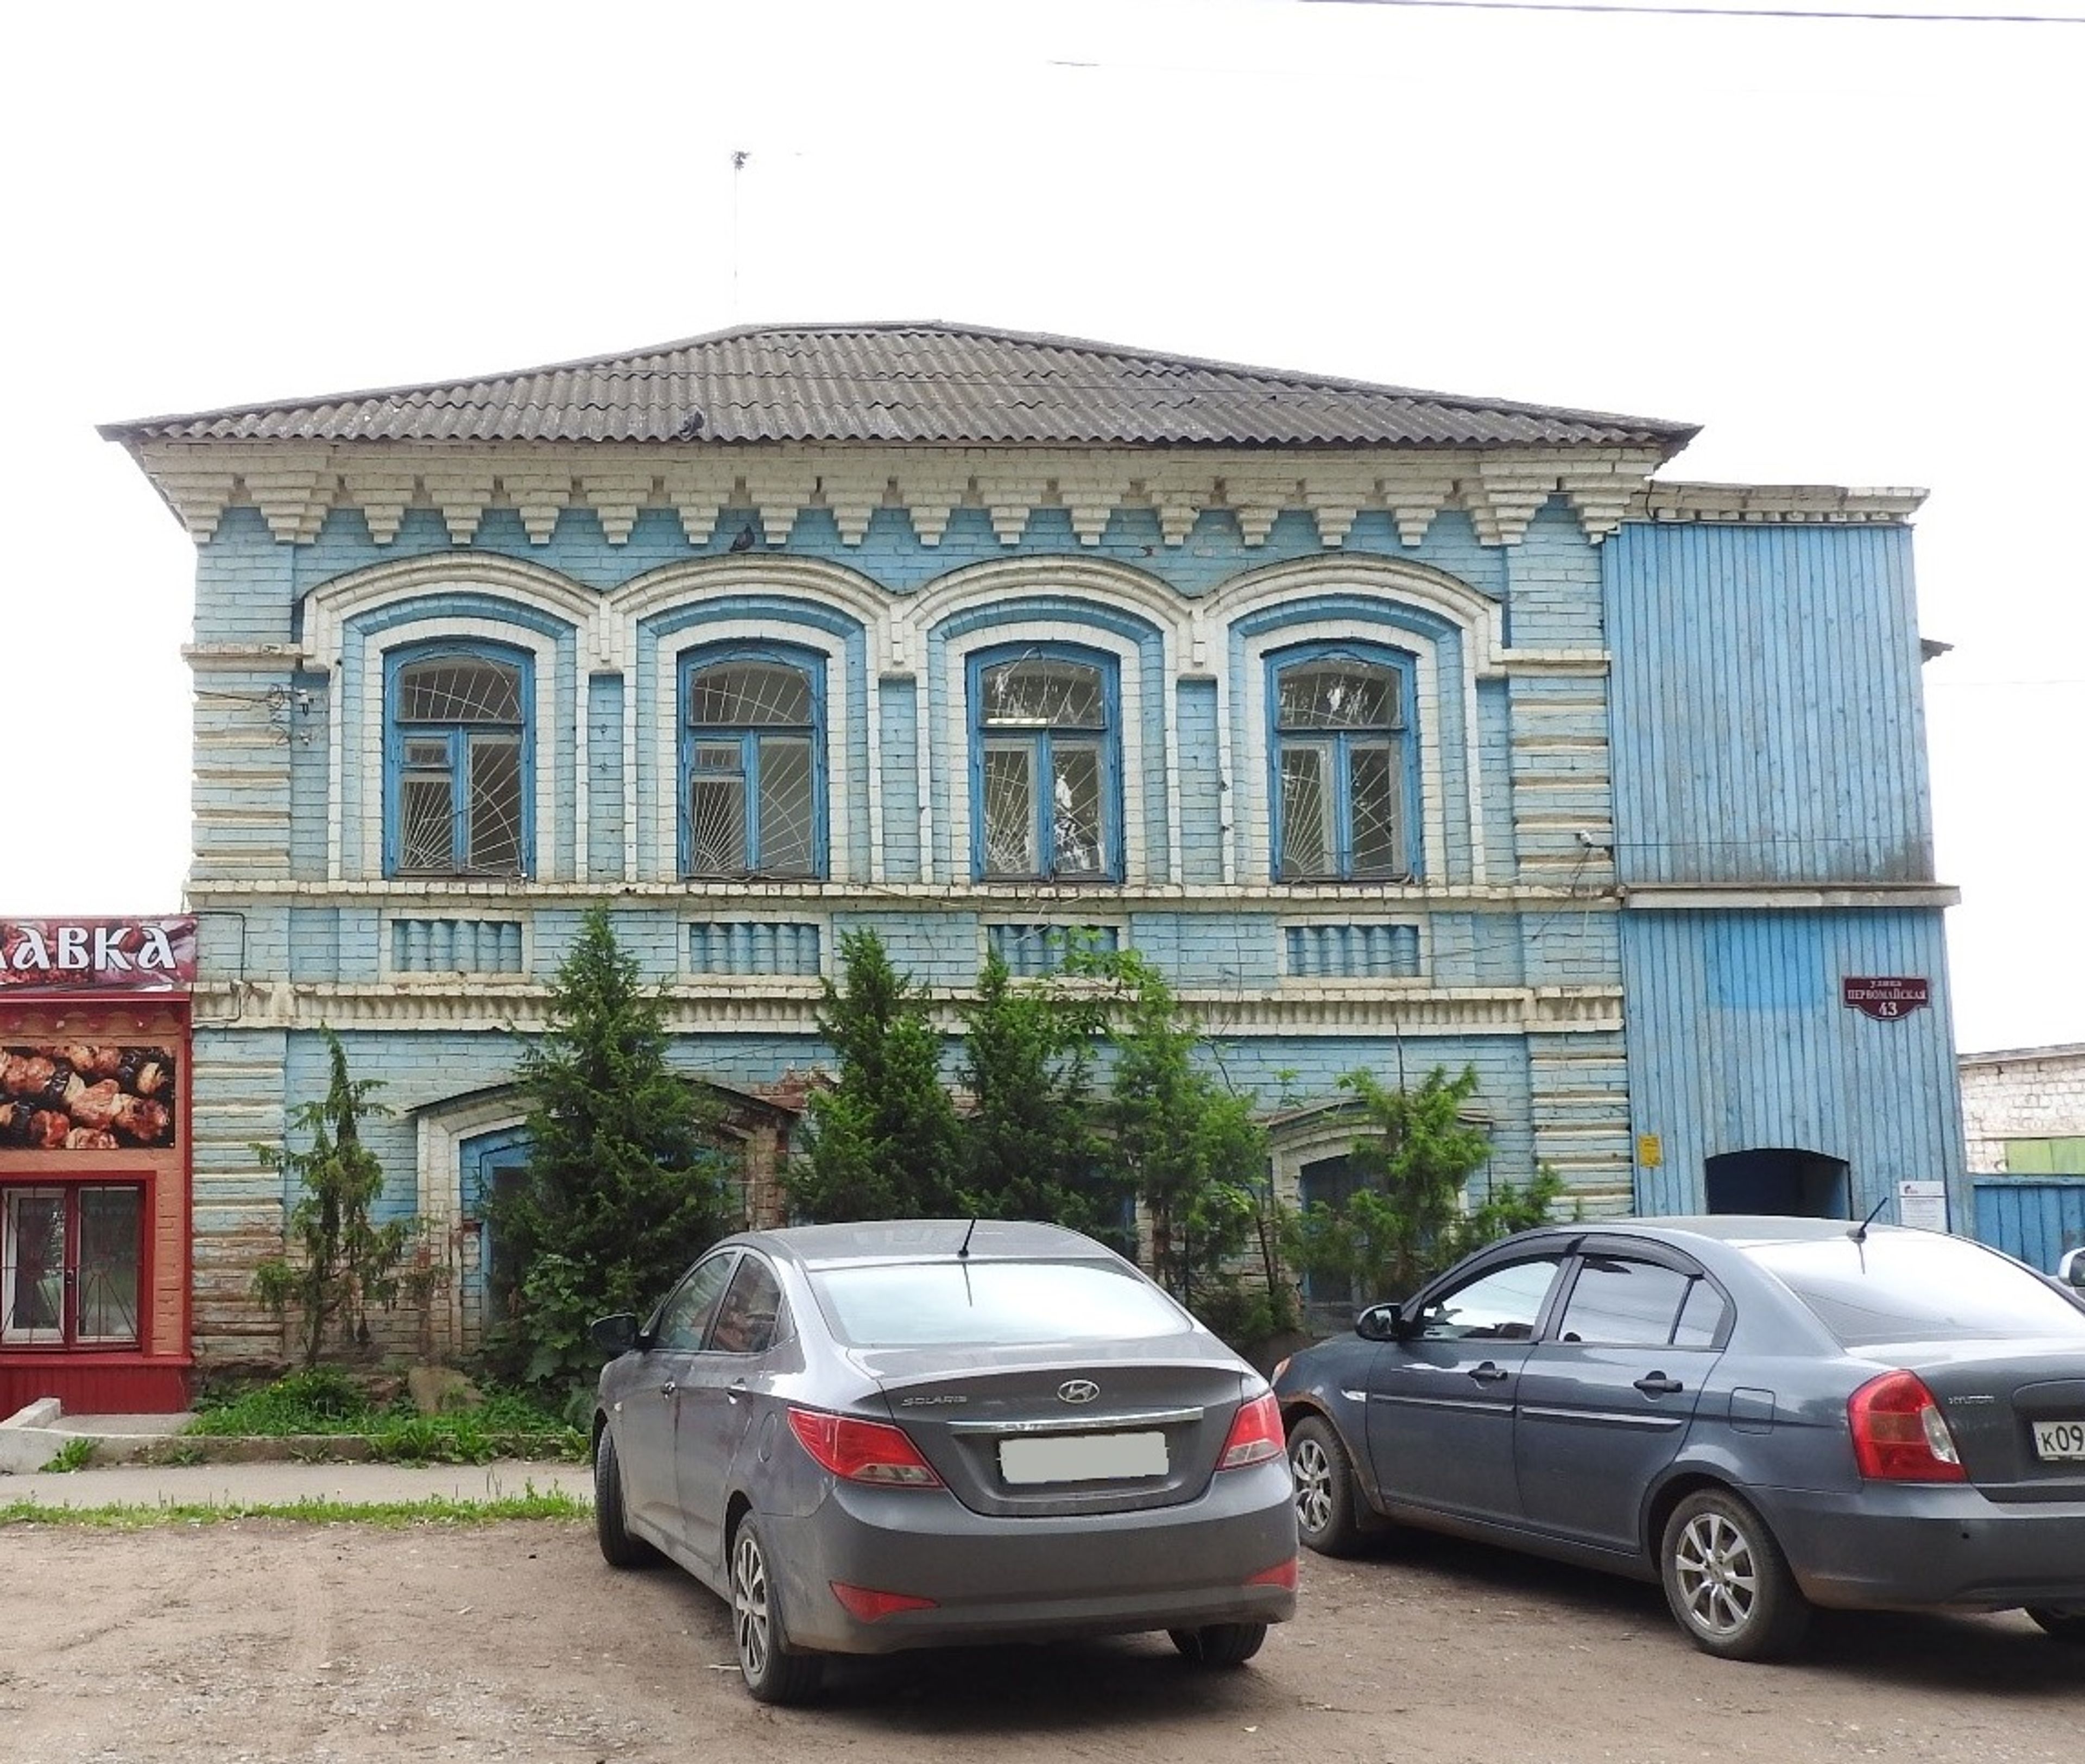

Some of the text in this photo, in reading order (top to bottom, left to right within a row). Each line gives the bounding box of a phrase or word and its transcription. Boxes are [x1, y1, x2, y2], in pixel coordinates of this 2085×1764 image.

[0, 927, 176, 970] АВКА
[1848, 988, 1926, 1000] ПЕРВОМАЙСКАЯ
[1879, 1002, 1898, 1016] 43
[901, 1395, 966, 1406] SOLARIS
